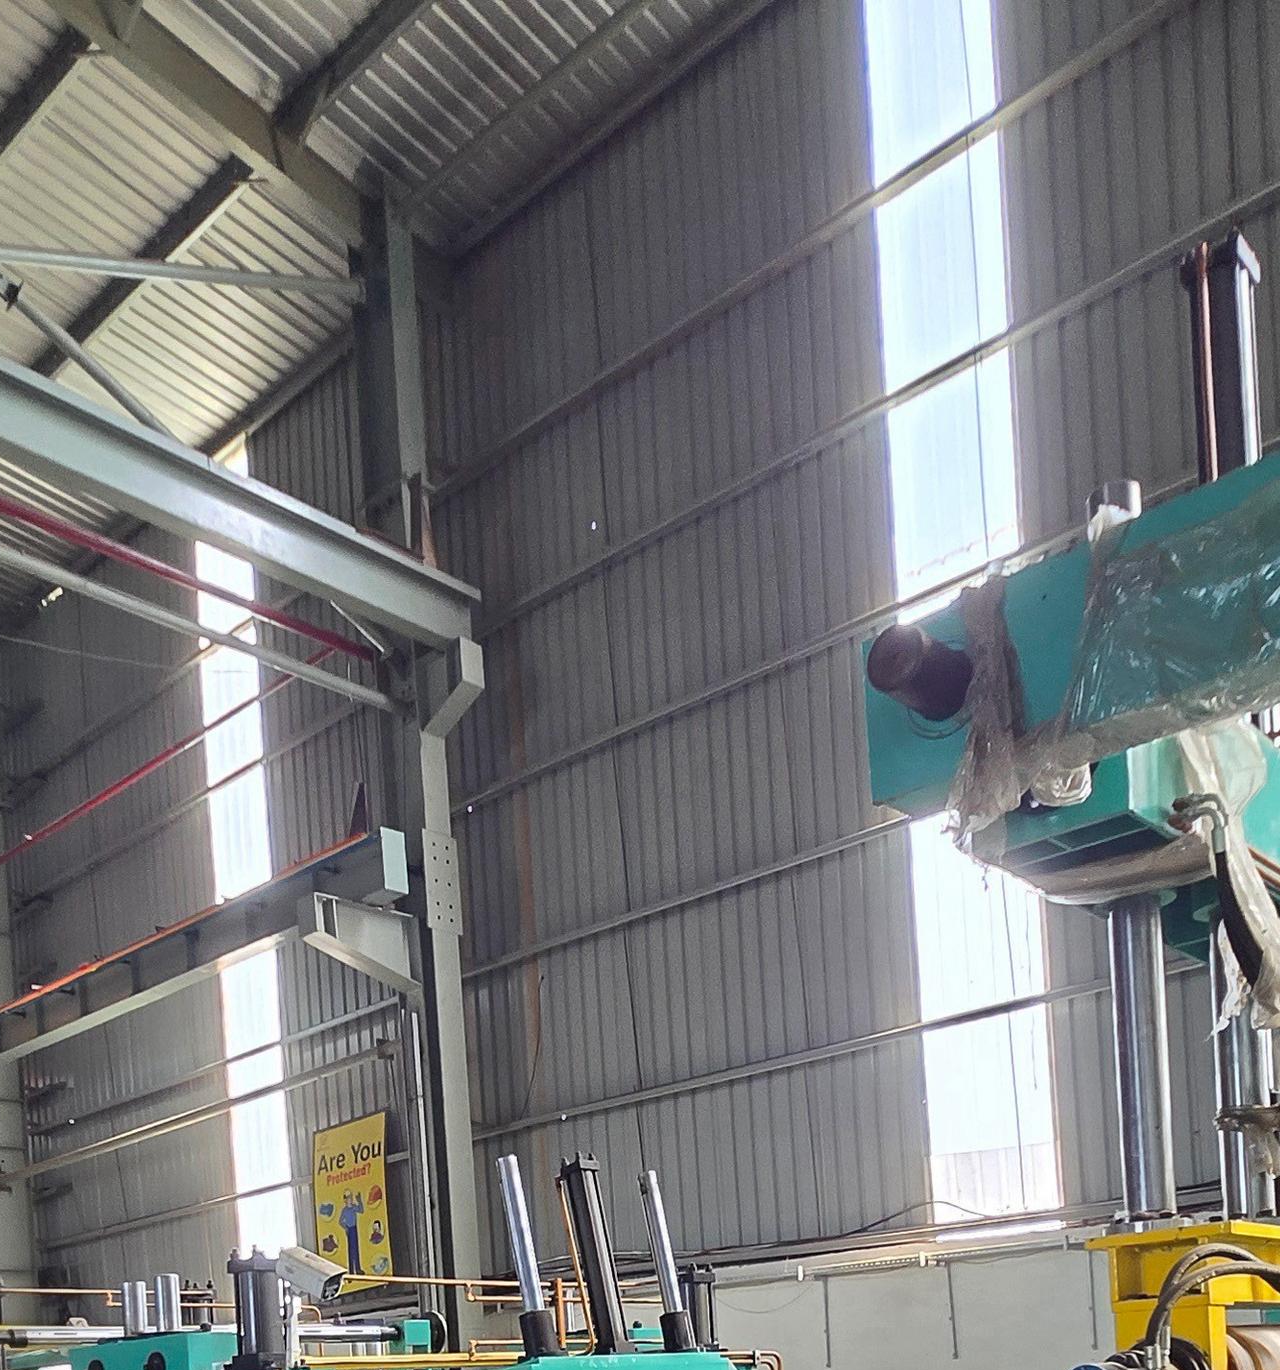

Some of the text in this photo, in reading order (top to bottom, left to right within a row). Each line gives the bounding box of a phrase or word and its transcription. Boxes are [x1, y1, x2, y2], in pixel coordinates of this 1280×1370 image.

[318, 1153, 345, 1175] Are
[351, 1141, 381, 1164] You
[327, 1162, 371, 1185] Protected?
